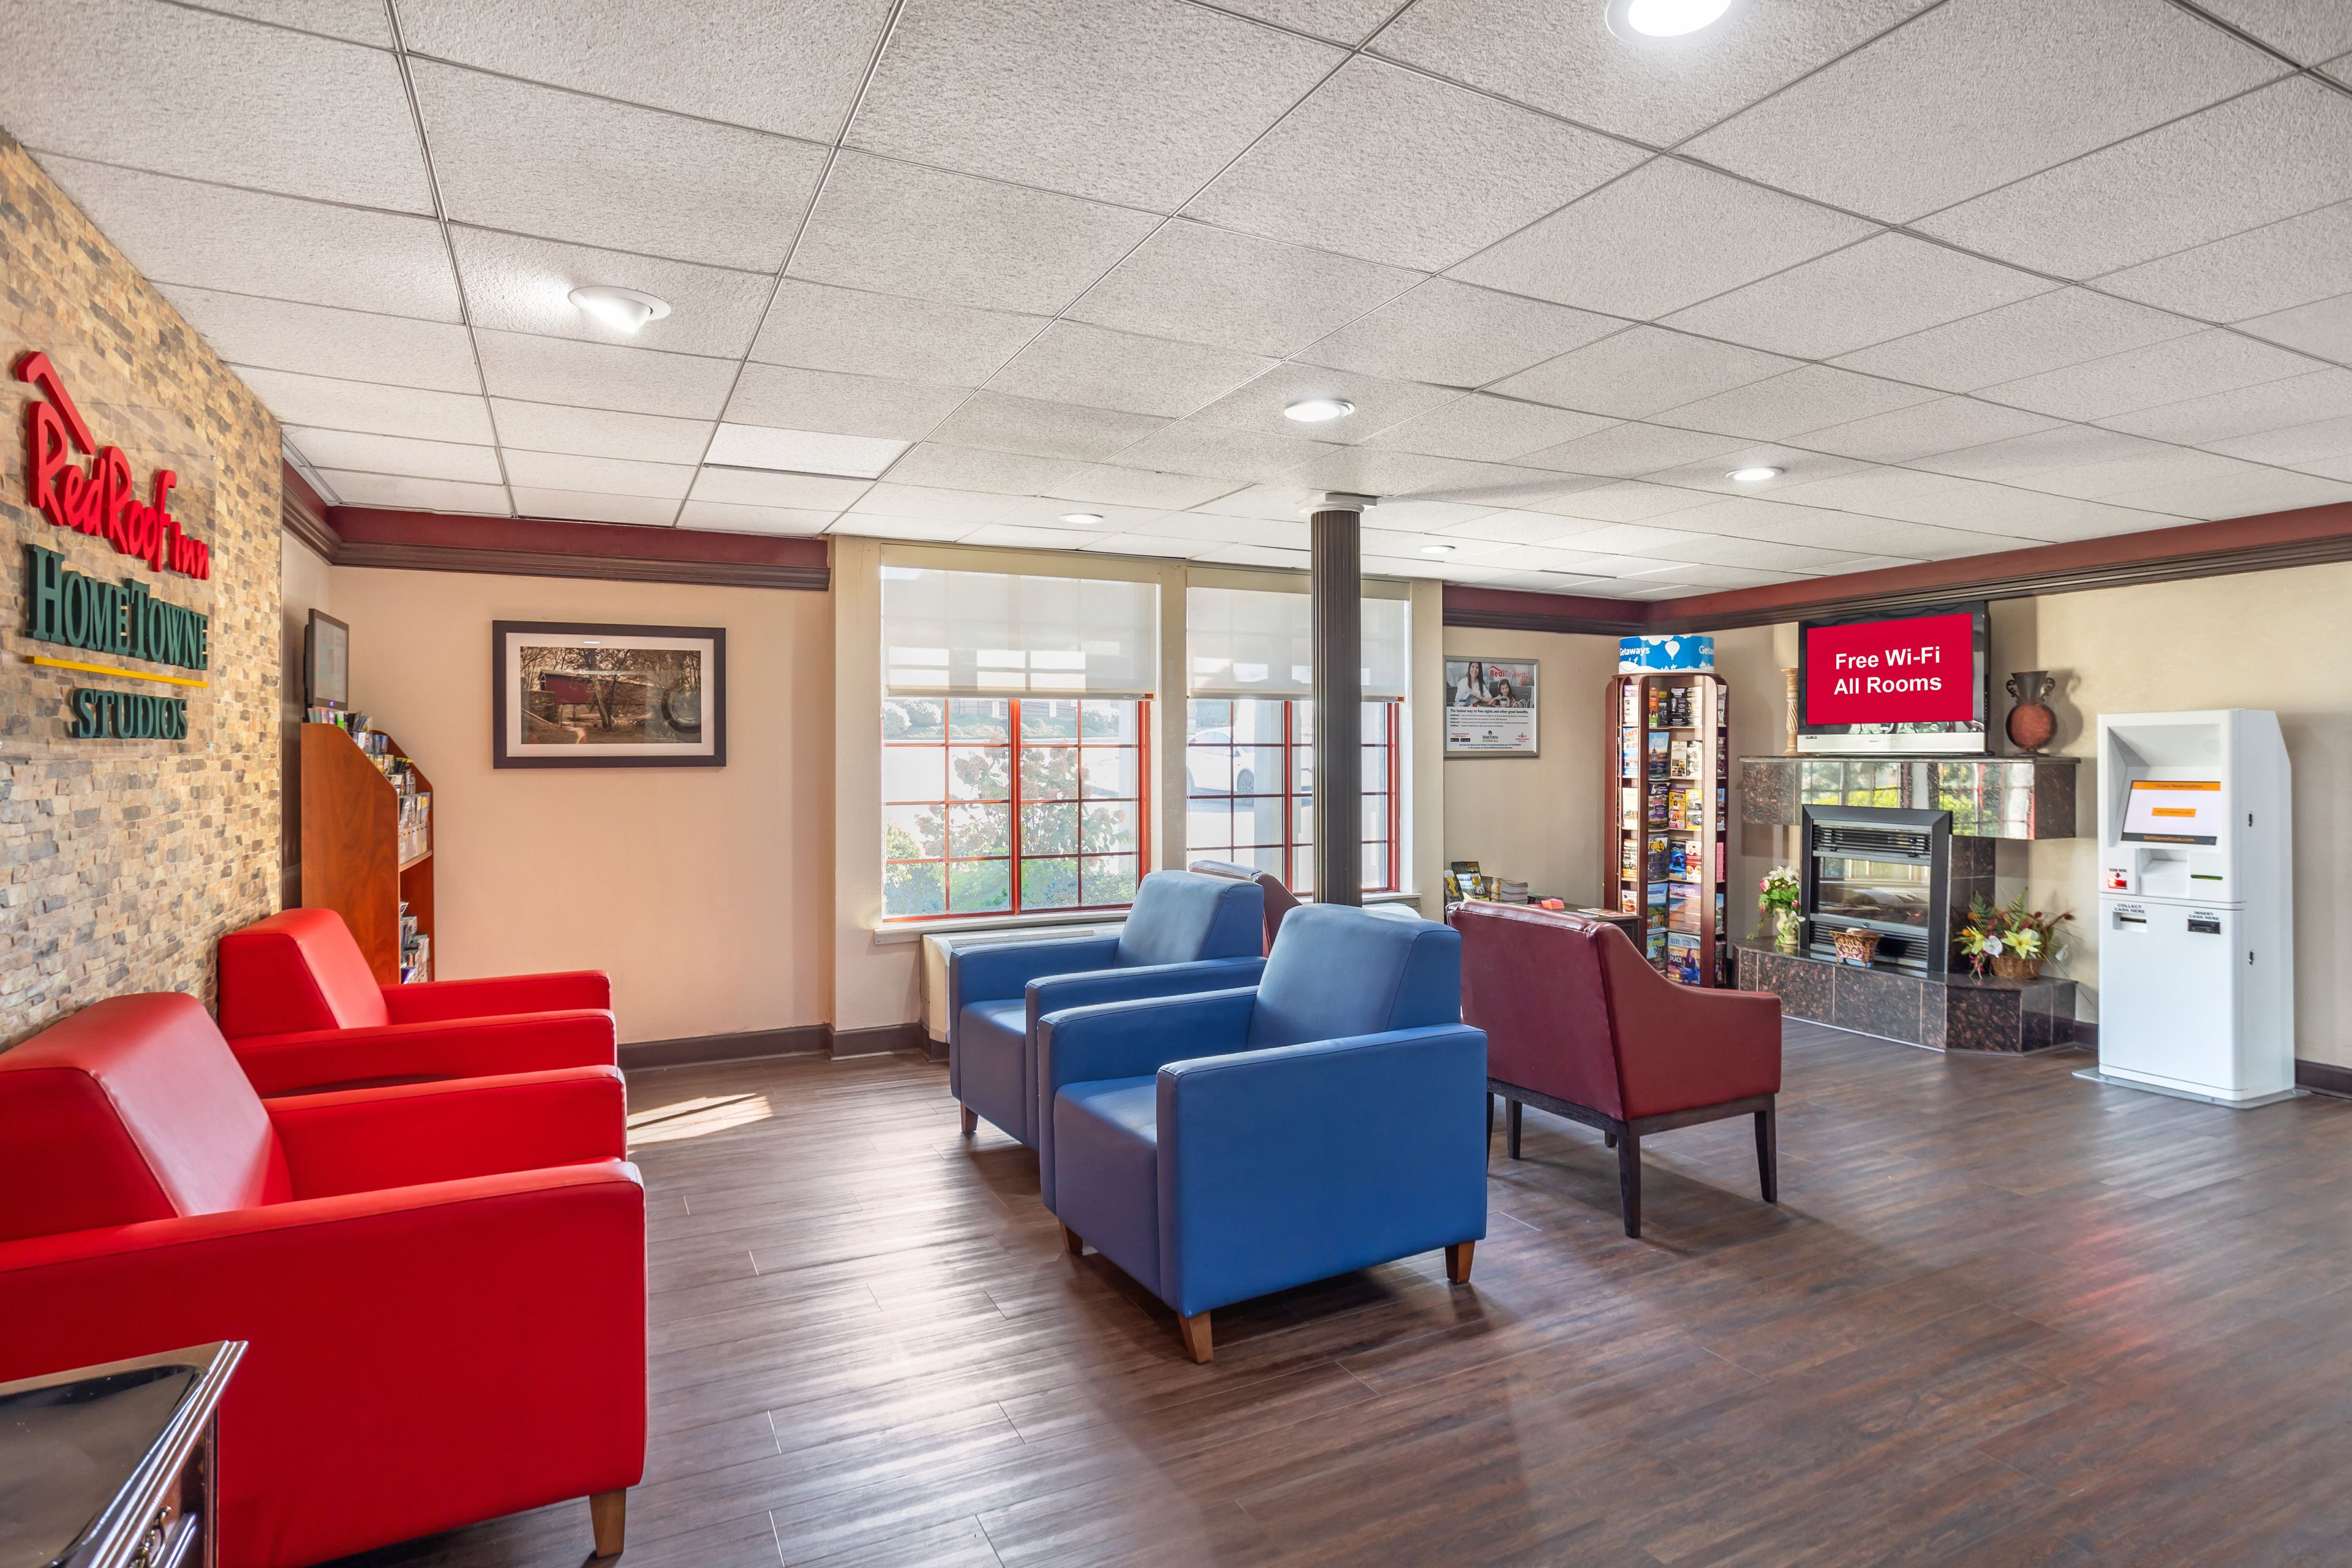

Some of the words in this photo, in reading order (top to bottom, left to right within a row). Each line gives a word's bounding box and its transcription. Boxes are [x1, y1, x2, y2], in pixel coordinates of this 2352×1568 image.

[1619, 647, 1650, 657] Getaways
[1836, 653, 1879, 669] Free
[1885, 646, 1940, 666] Wi-Fi
[1833, 677, 1860, 695] All
[1867, 676, 1942, 693] Rooms
[72, 687, 187, 740] STUDIOS
